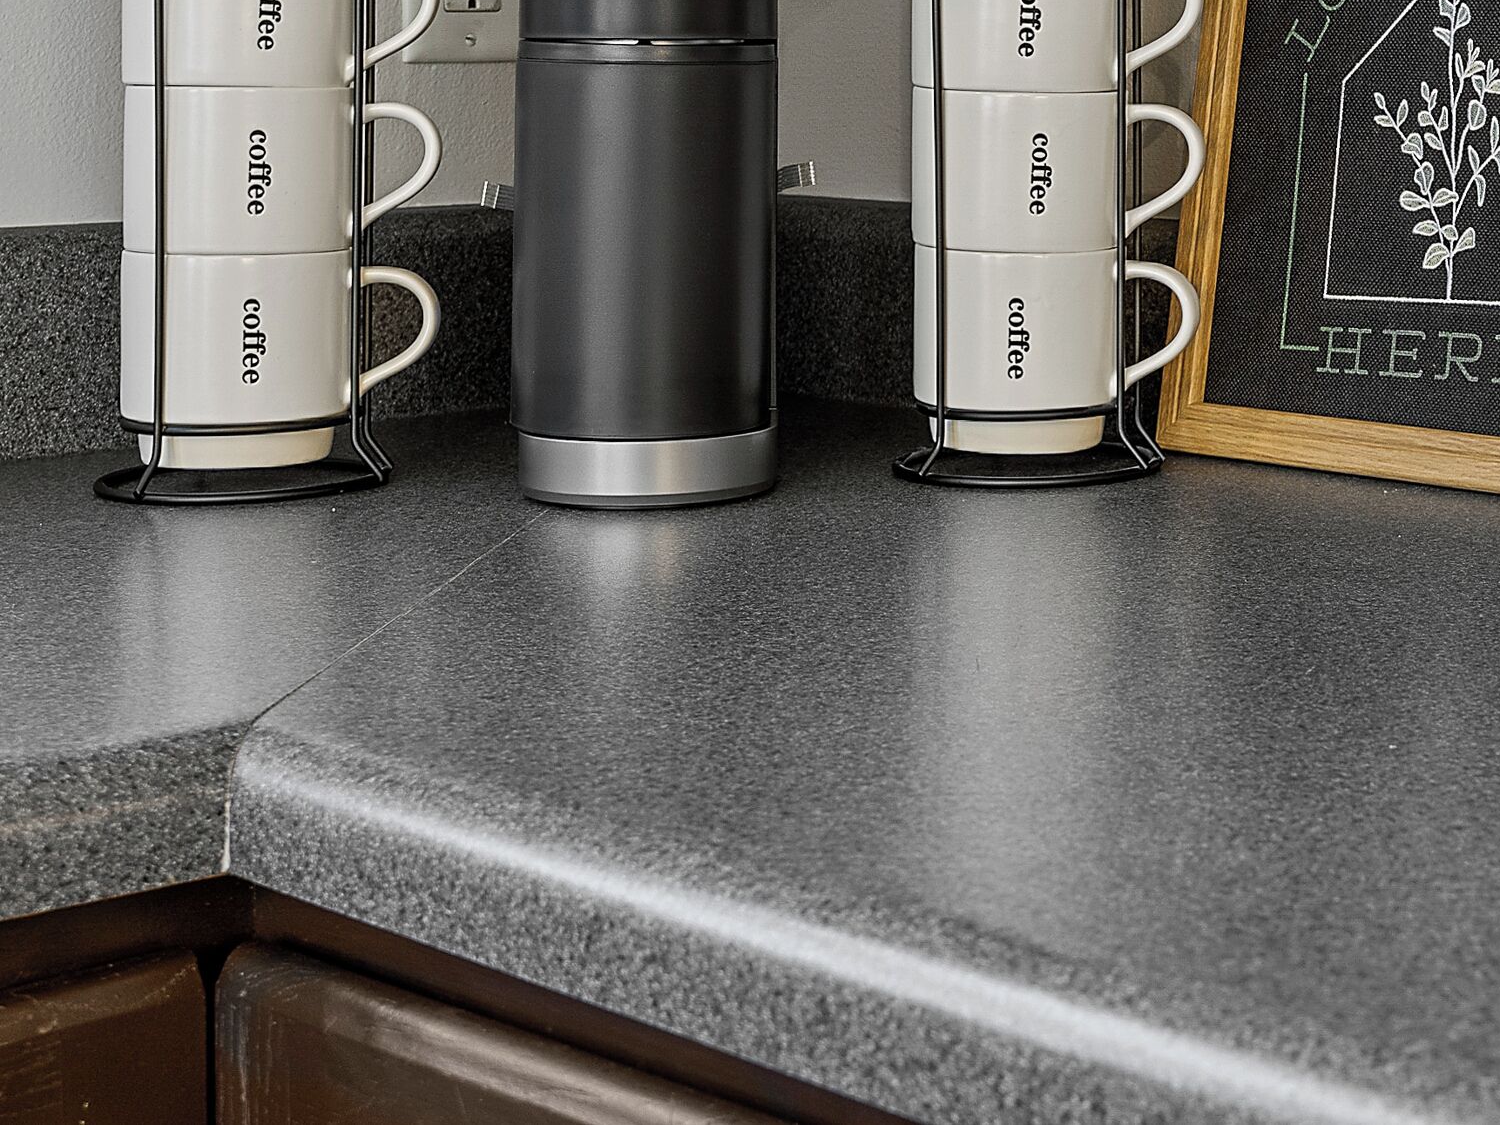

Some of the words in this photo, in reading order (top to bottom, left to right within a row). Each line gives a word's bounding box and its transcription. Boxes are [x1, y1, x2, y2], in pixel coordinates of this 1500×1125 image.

[246, 129, 272, 215] coffee
[1029, 132, 1053, 215] coffee
[241, 298, 267, 384] coffee
[1007, 297, 1030, 380] coffee
